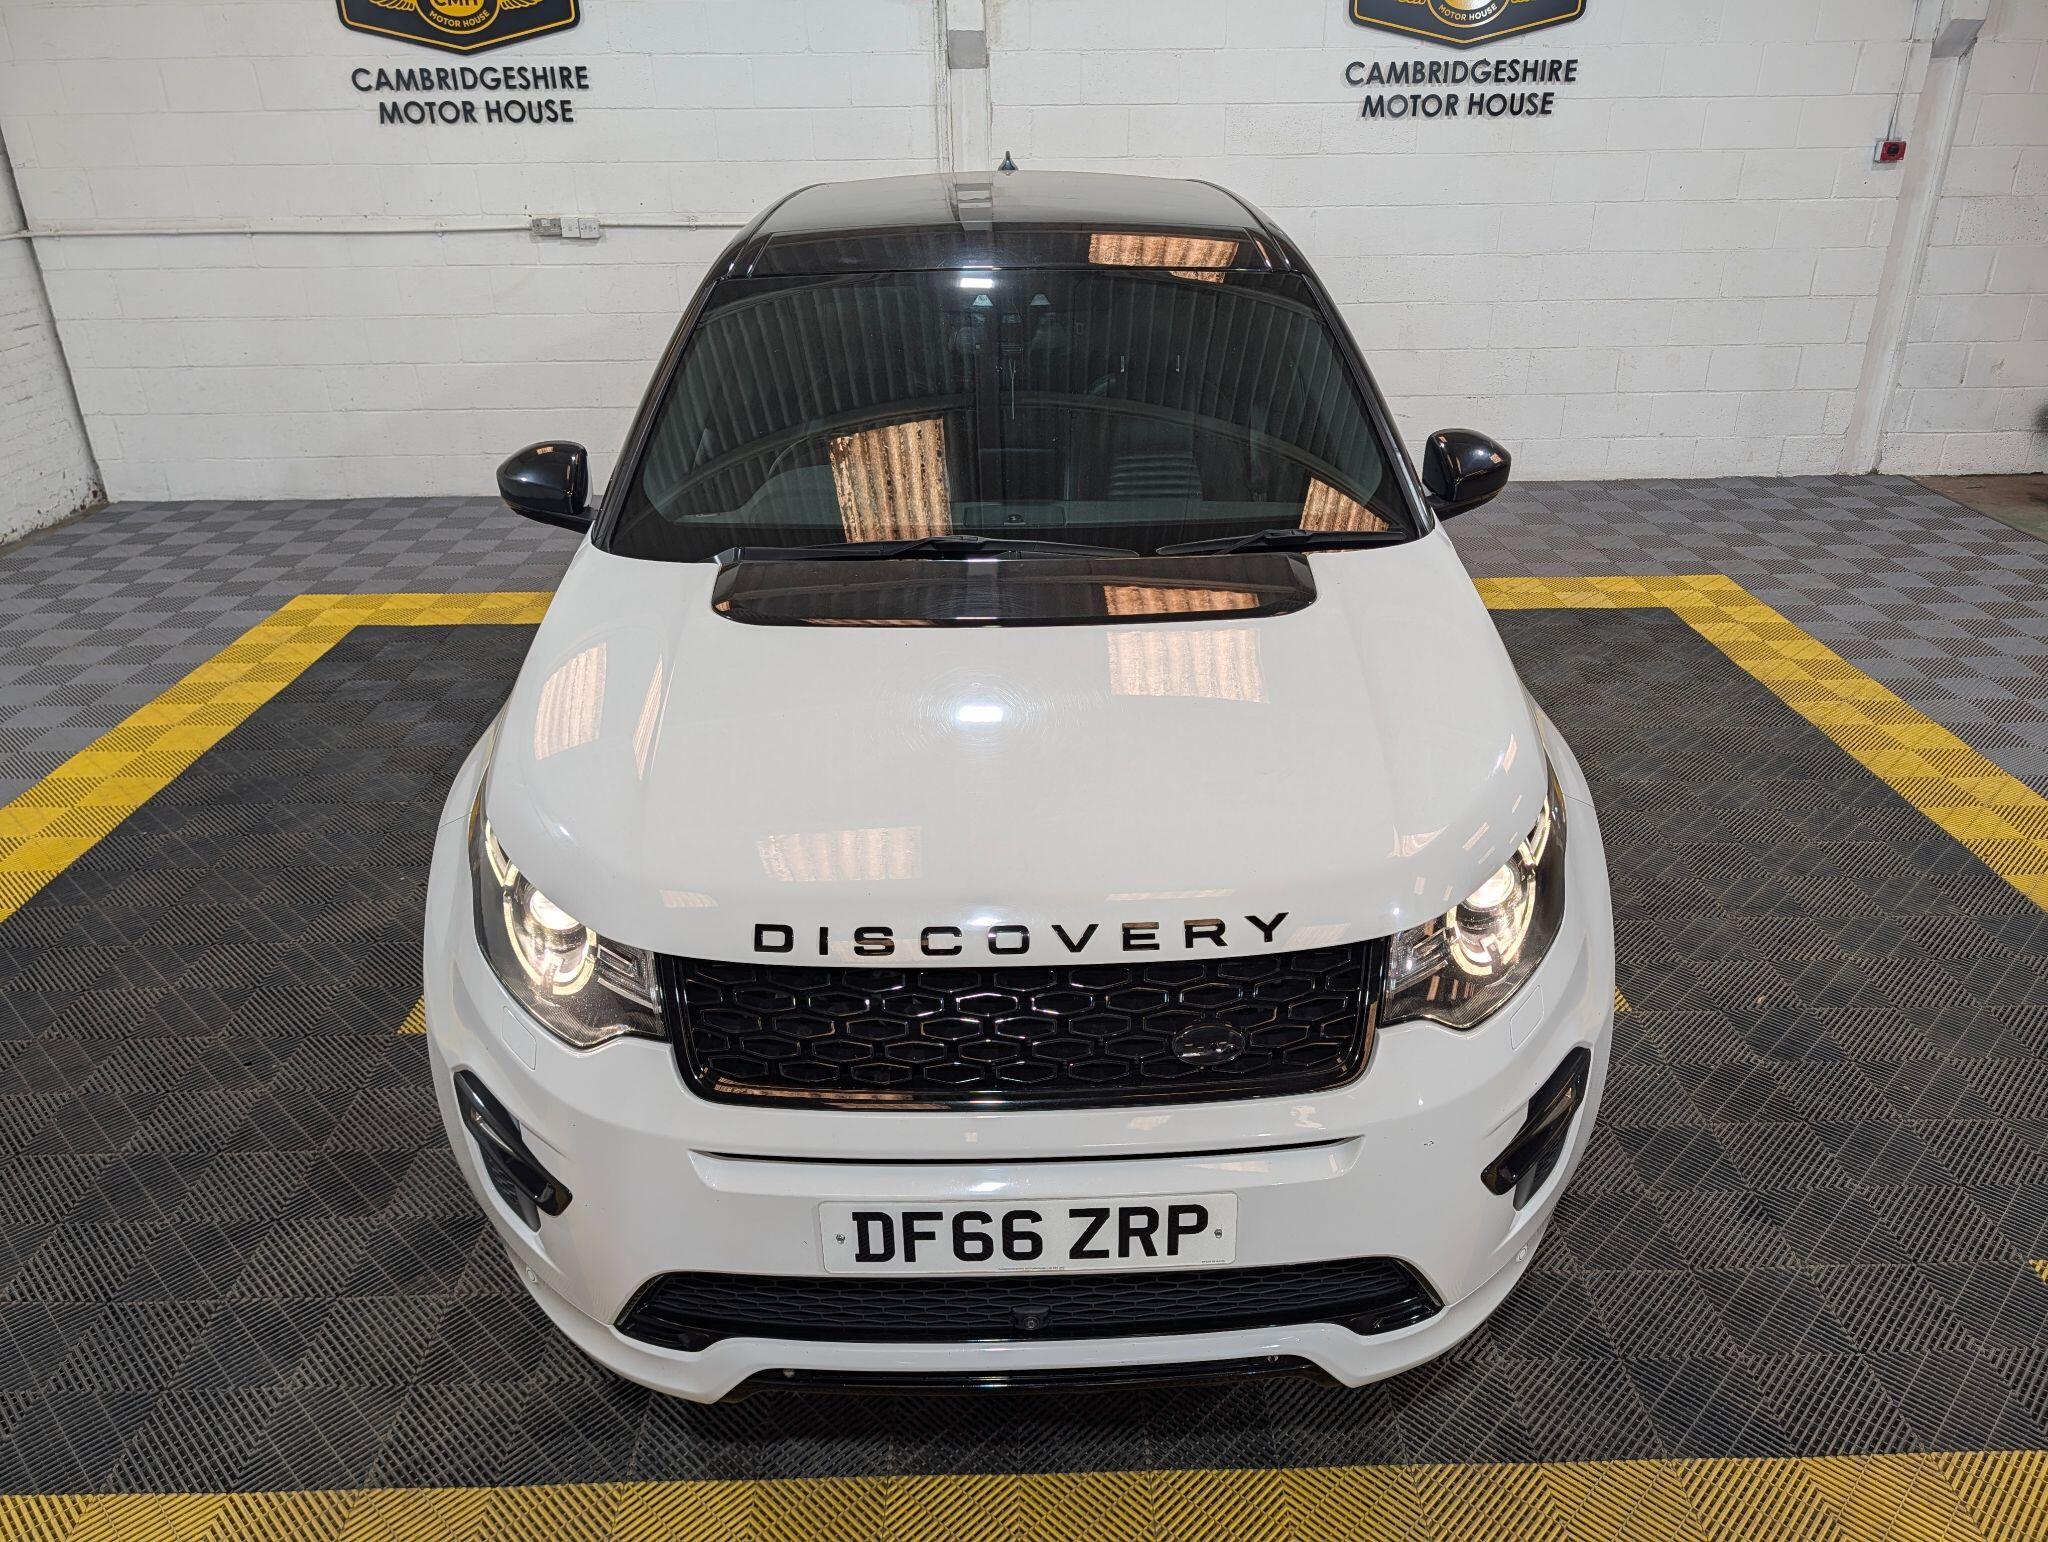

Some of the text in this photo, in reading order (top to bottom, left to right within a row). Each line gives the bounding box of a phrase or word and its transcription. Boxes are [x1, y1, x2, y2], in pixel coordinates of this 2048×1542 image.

[429, 9, 490, 28] MOTOR HOUSE
[1438, 3, 1498, 21] MOTOR HOUSE
[351, 66, 589, 92] CAMBRIDGESHIRE
[1345, 58, 1578, 85] CAMBRIDGESHIRE
[379, 99, 574, 125] MOTOR HOUSE
[1361, 92, 1555, 118] MOTOR HOUSE
[754, 912, 1289, 957] DISCOVERY
[852, 1204, 1209, 1263] DF66 ZRP
